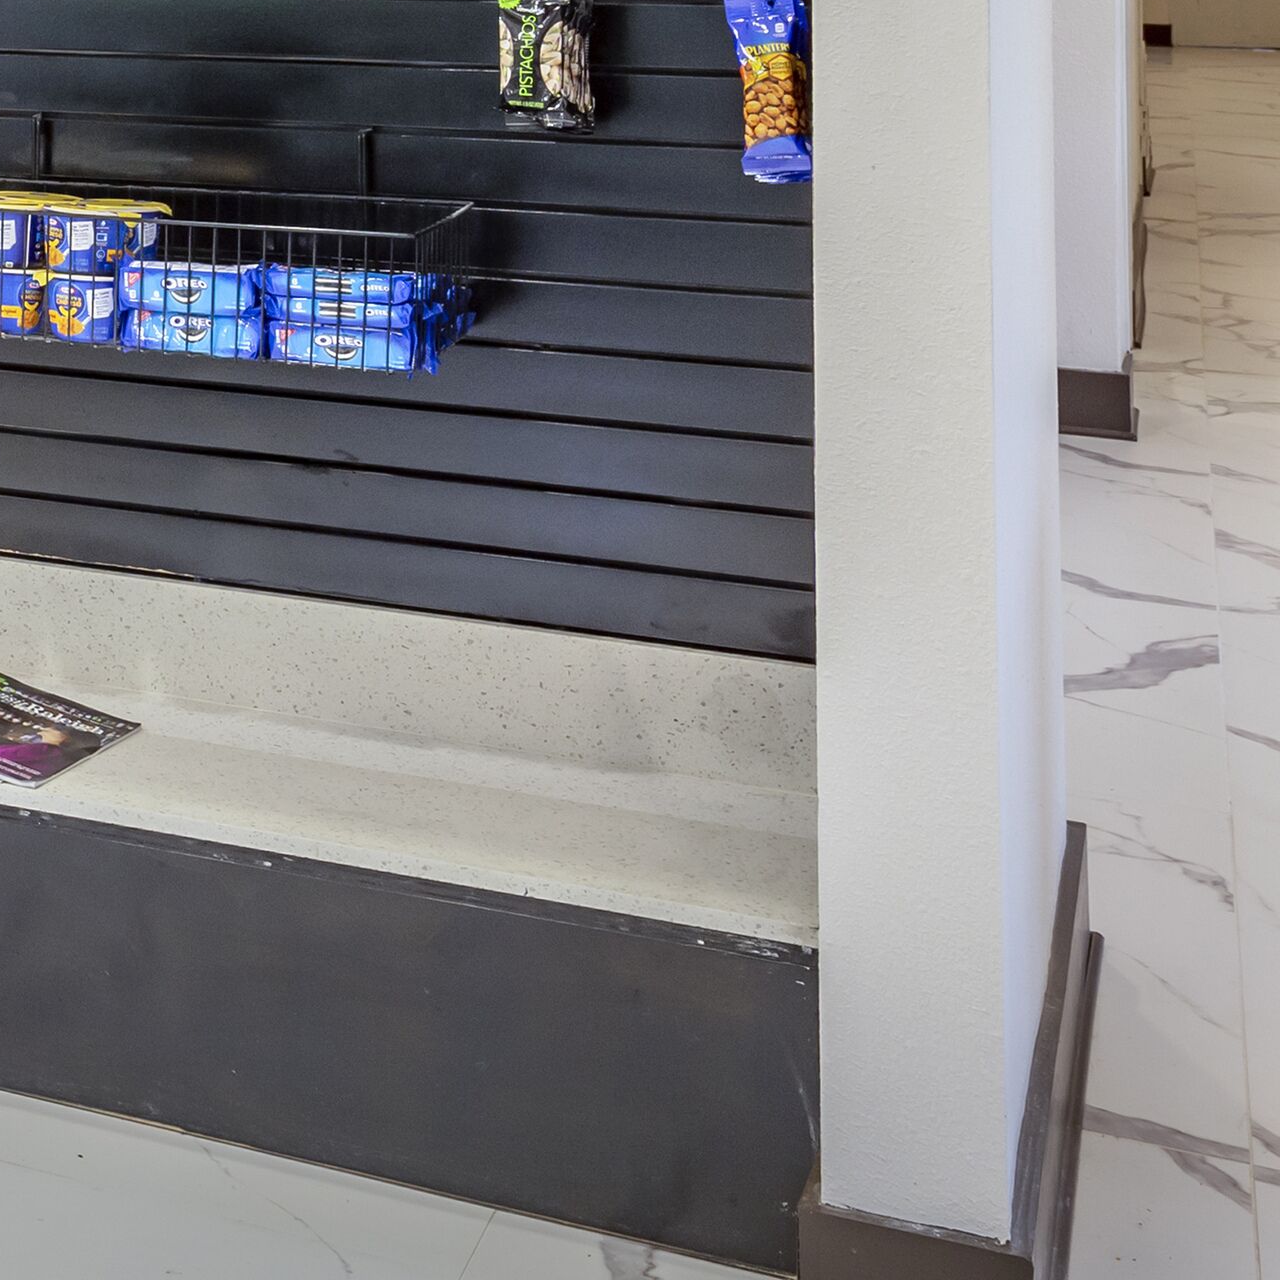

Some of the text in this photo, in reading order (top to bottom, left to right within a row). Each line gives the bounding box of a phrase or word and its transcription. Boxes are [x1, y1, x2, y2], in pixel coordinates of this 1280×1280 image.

[518, 15, 537, 97] PISTACHIOS
[745, 42, 790, 56] PLANTERS
[162, 277, 207, 290] OREO
[315, 334, 363, 348] OREO
